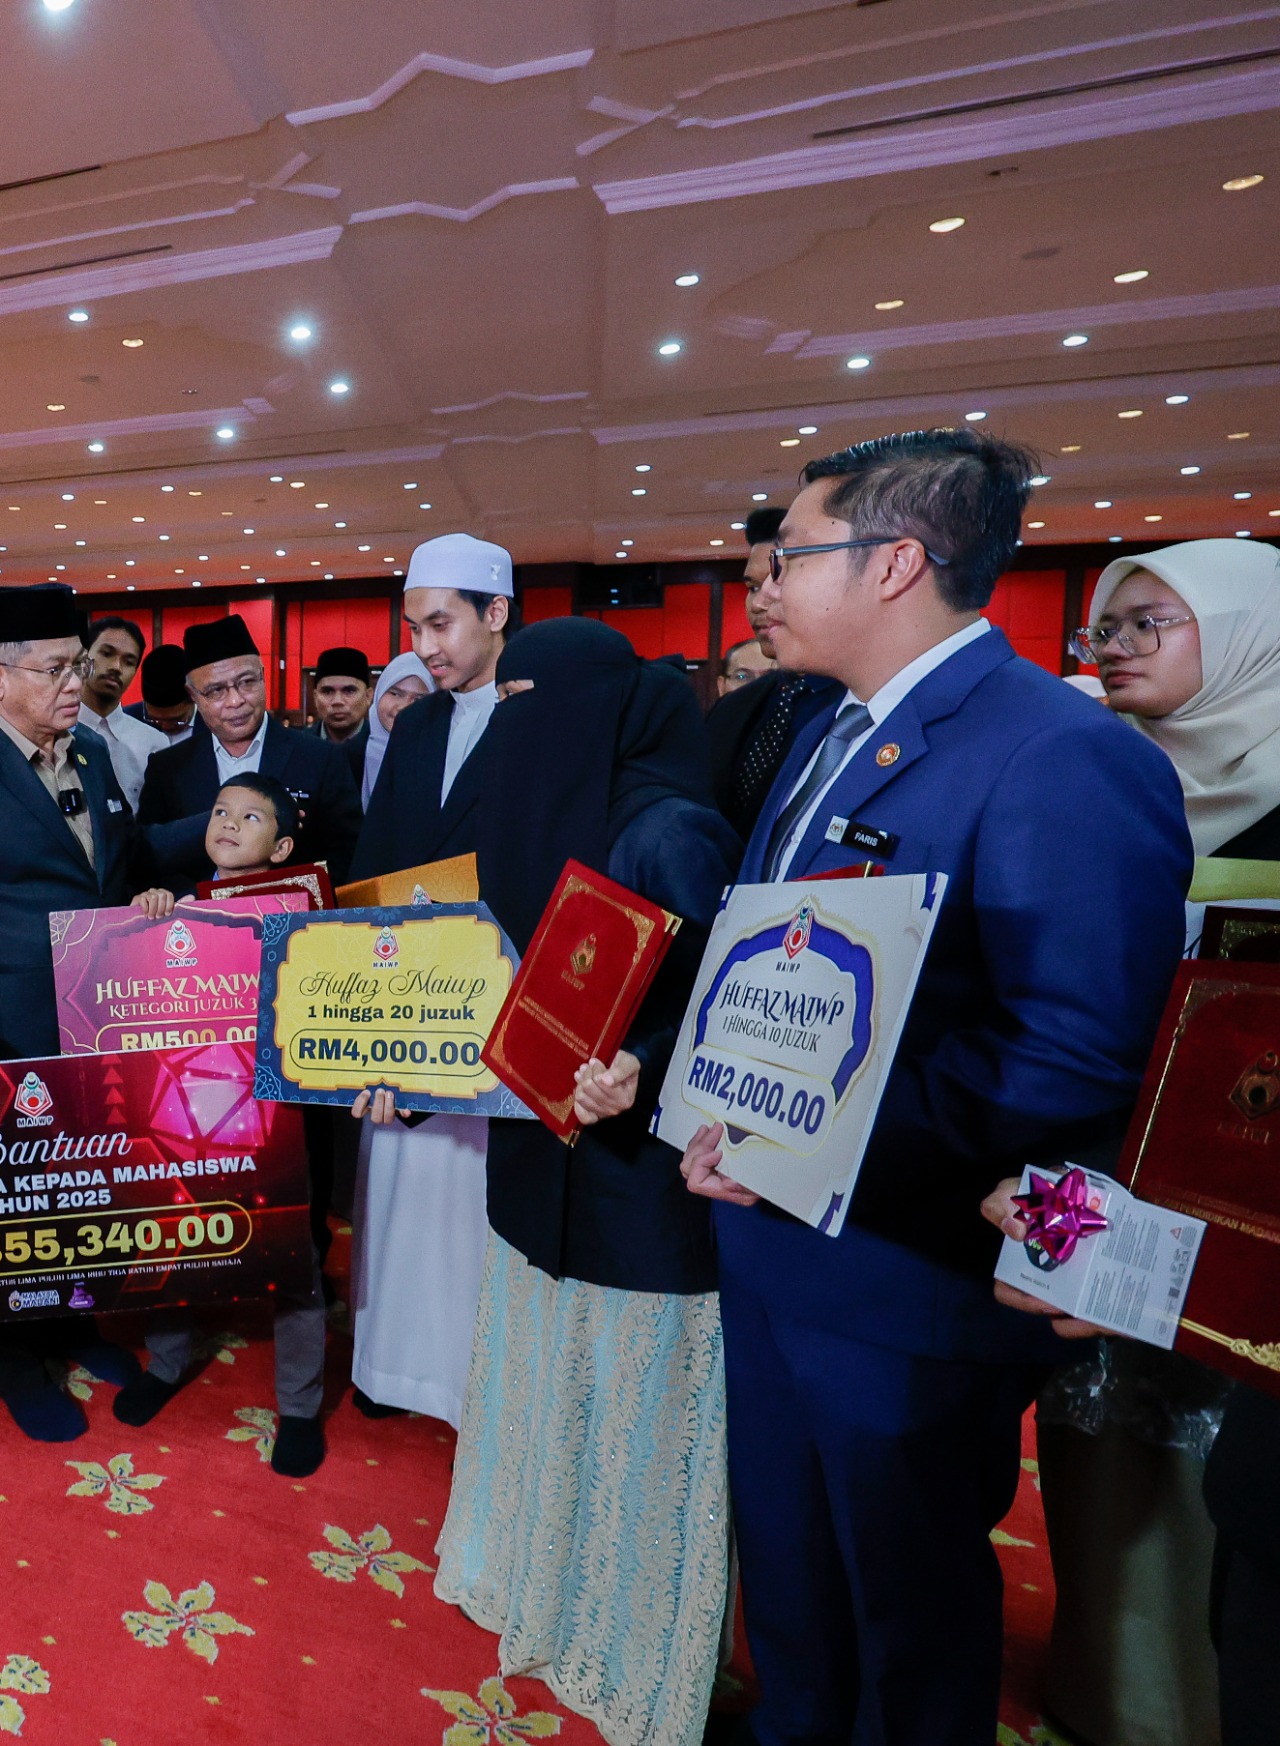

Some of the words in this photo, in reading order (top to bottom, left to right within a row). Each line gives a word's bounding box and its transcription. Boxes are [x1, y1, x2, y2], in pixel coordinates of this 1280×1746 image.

[854, 831, 878, 847] FARIS
[166, 958, 198, 968] MAIWP
[776, 961, 801, 974] MAIWP
[96, 976, 199, 1004] HUFFAZ
[192, 970, 260, 997] MAIW
[299, 971, 383, 1004] Huffaz
[388, 965, 488, 1004] Maiwp
[109, 1000, 190, 1019] KETEGORI
[194, 996, 245, 1014] JUZUK
[308, 1005, 317, 1018] 1
[323, 1004, 384, 1022] hingga
[390, 1005, 414, 1019] 20
[419, 1004, 475, 1024] juzuk
[719, 980, 781, 1023] HUFFAZ
[780, 990, 845, 1028] MAIWP
[726, 1014, 768, 1040] HINGGA
[779, 1028, 821, 1053] JUZUK
[299, 1038, 480, 1067] RM4,000.00
[687, 1055, 826, 1135] RM2,000.00
[16, 1115, 53, 1127] MAIWP
[14, 1169, 108, 1193] KEPADA
[112, 1155, 257, 1185] MAHASISWA
[57, 1189, 112, 1209] 2025
[17, 1276, 37, 1285] LIMA
[67, 1271, 86, 1280] LIMA
[155, 1263, 182, 1273] EMPAT
